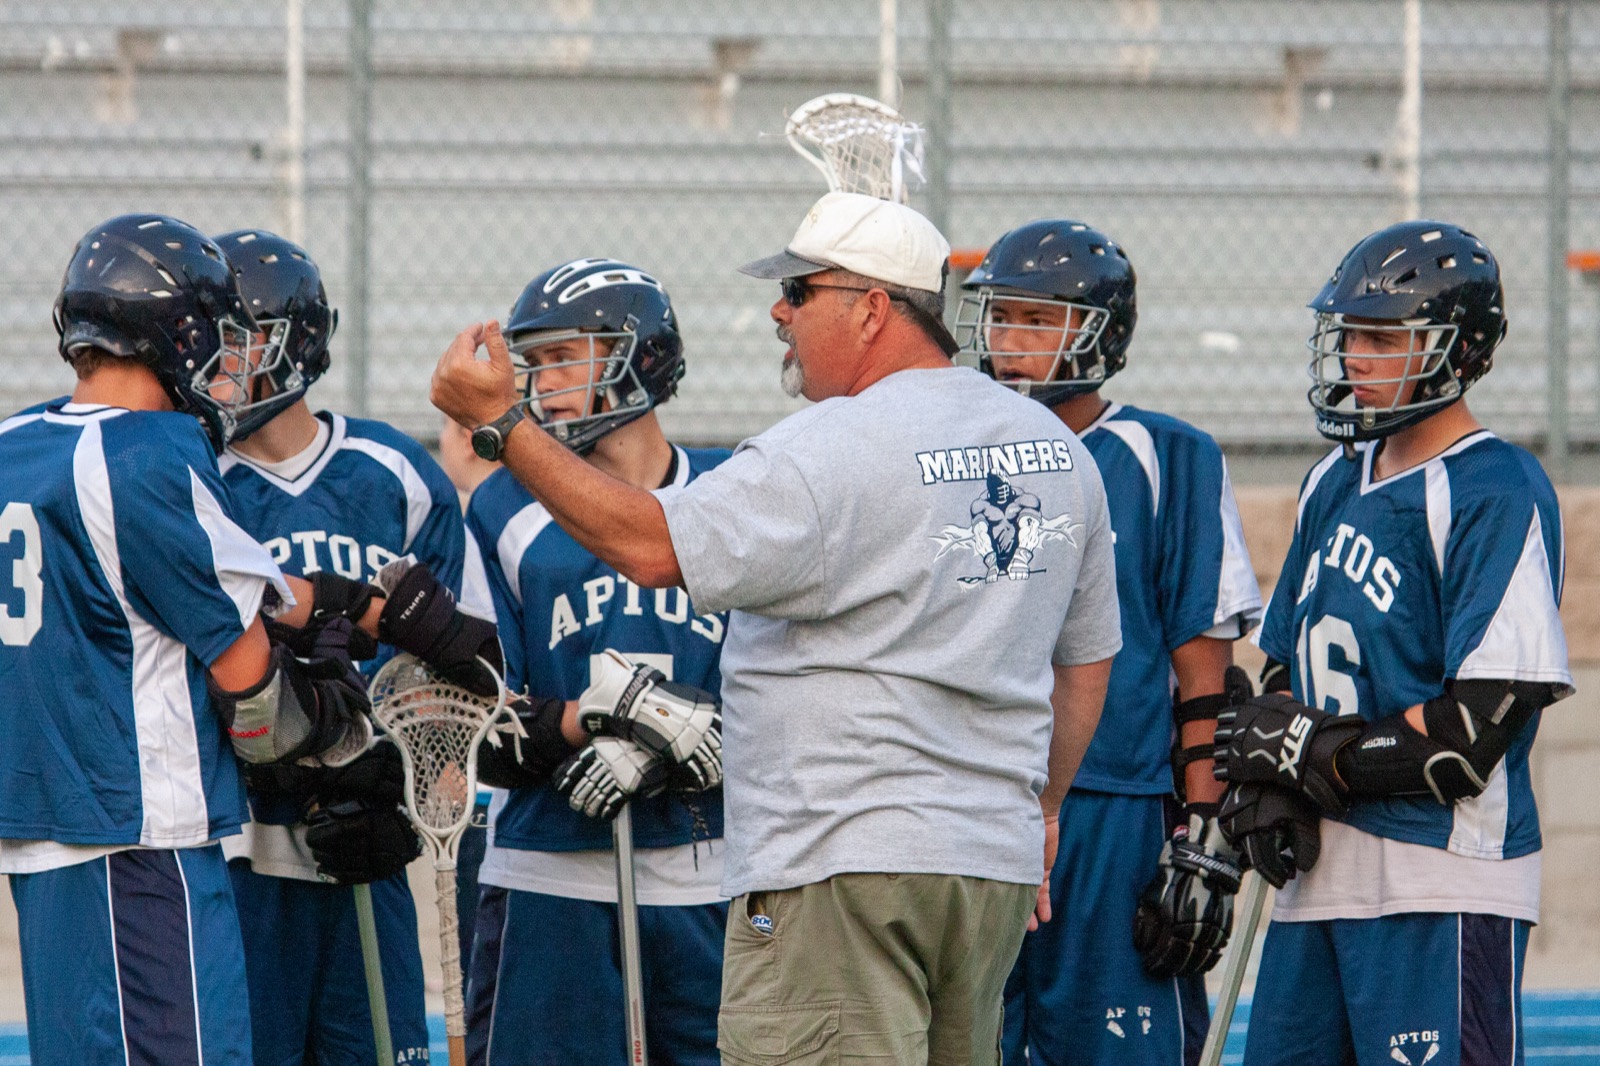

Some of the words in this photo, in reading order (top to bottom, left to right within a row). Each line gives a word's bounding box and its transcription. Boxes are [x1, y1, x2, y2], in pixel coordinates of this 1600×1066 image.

[915, 439, 1073, 485] MARINERS
[261, 530, 400, 583] PTOS
[1297, 522, 1402, 613] ATOS
[400, 590, 426, 620] TEMPO
[1278, 713, 1313, 780] STX
[397, 1046, 429, 1063] APTO
[634, 1040, 642, 1064] PRO
[1390, 1030, 1439, 1047] APTOS
